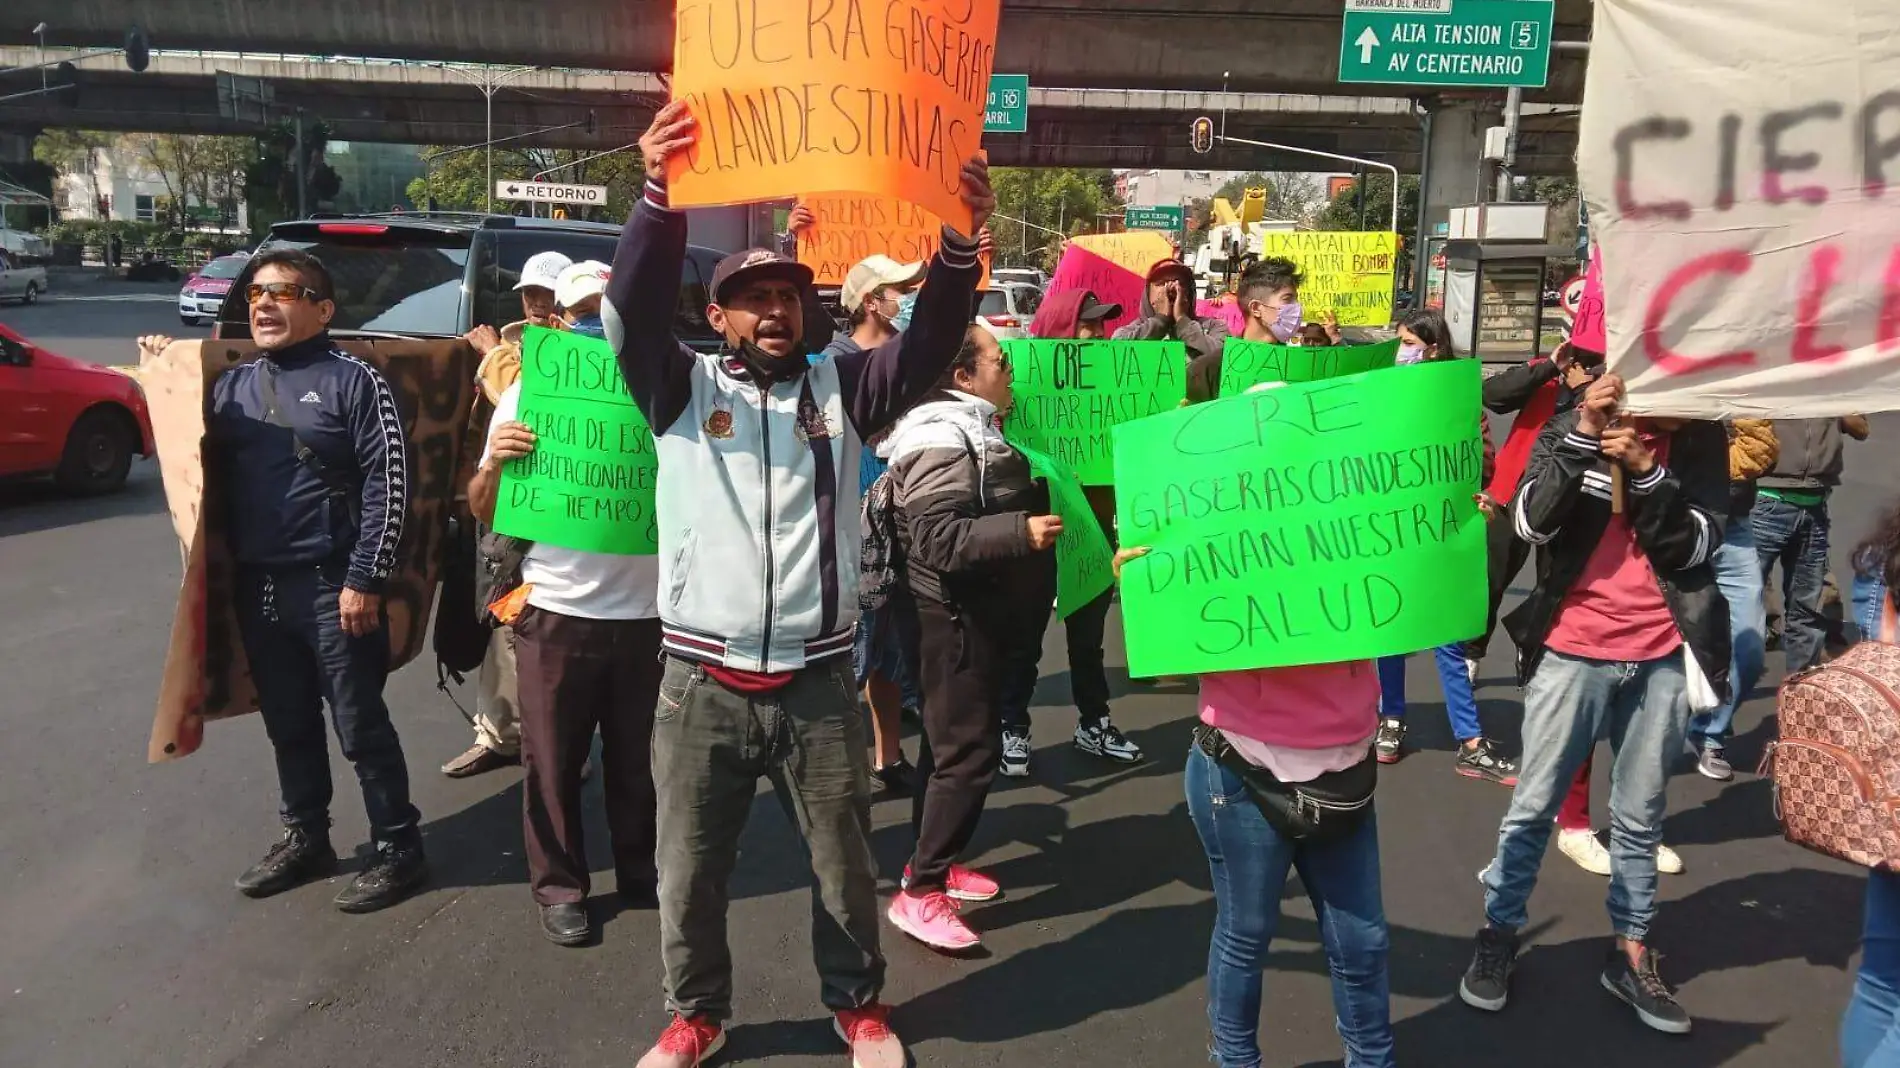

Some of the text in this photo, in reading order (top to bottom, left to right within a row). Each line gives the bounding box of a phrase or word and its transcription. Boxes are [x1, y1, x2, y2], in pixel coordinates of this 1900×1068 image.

[1391, 23, 1426, 43] ALTA
[1434, 24, 1502, 45] TENSION
[678, 0, 993, 117] FUERA GASERAS
[1388, 53, 1524, 75] AV CENTENARIO
[984, 111, 1012, 125] ARRIL
[1003, 93, 1018, 105] 10
[684, 80, 966, 196] CLANDESTINAS
[526, 186, 597, 200] RETORNO
[897, 199, 925, 229] EN
[804, 230, 871, 262] APOYO
[878, 230, 896, 260] Y
[1268, 233, 1390, 253] IXTAPALUCA
[1352, 253, 1394, 272] BOMBAS
[1644, 245, 1900, 377] CL
[1007, 341, 1044, 388] LA
[1112, 346, 1145, 389] VA
[1155, 347, 1176, 388] A
[1009, 391, 1163, 430] ACTUAR HASTA
[1173, 382, 1363, 456] CRE
[522, 409, 656, 457] CERCA DE ESC
[511, 482, 643, 522] DE TIEMPO
[1131, 436, 1482, 532] GASERAS CLANDESTINAS
[1146, 526, 1295, 594] DAÑAN
[1304, 498, 1461, 562] NUESTRA
[1195, 573, 1403, 655] SALUD
